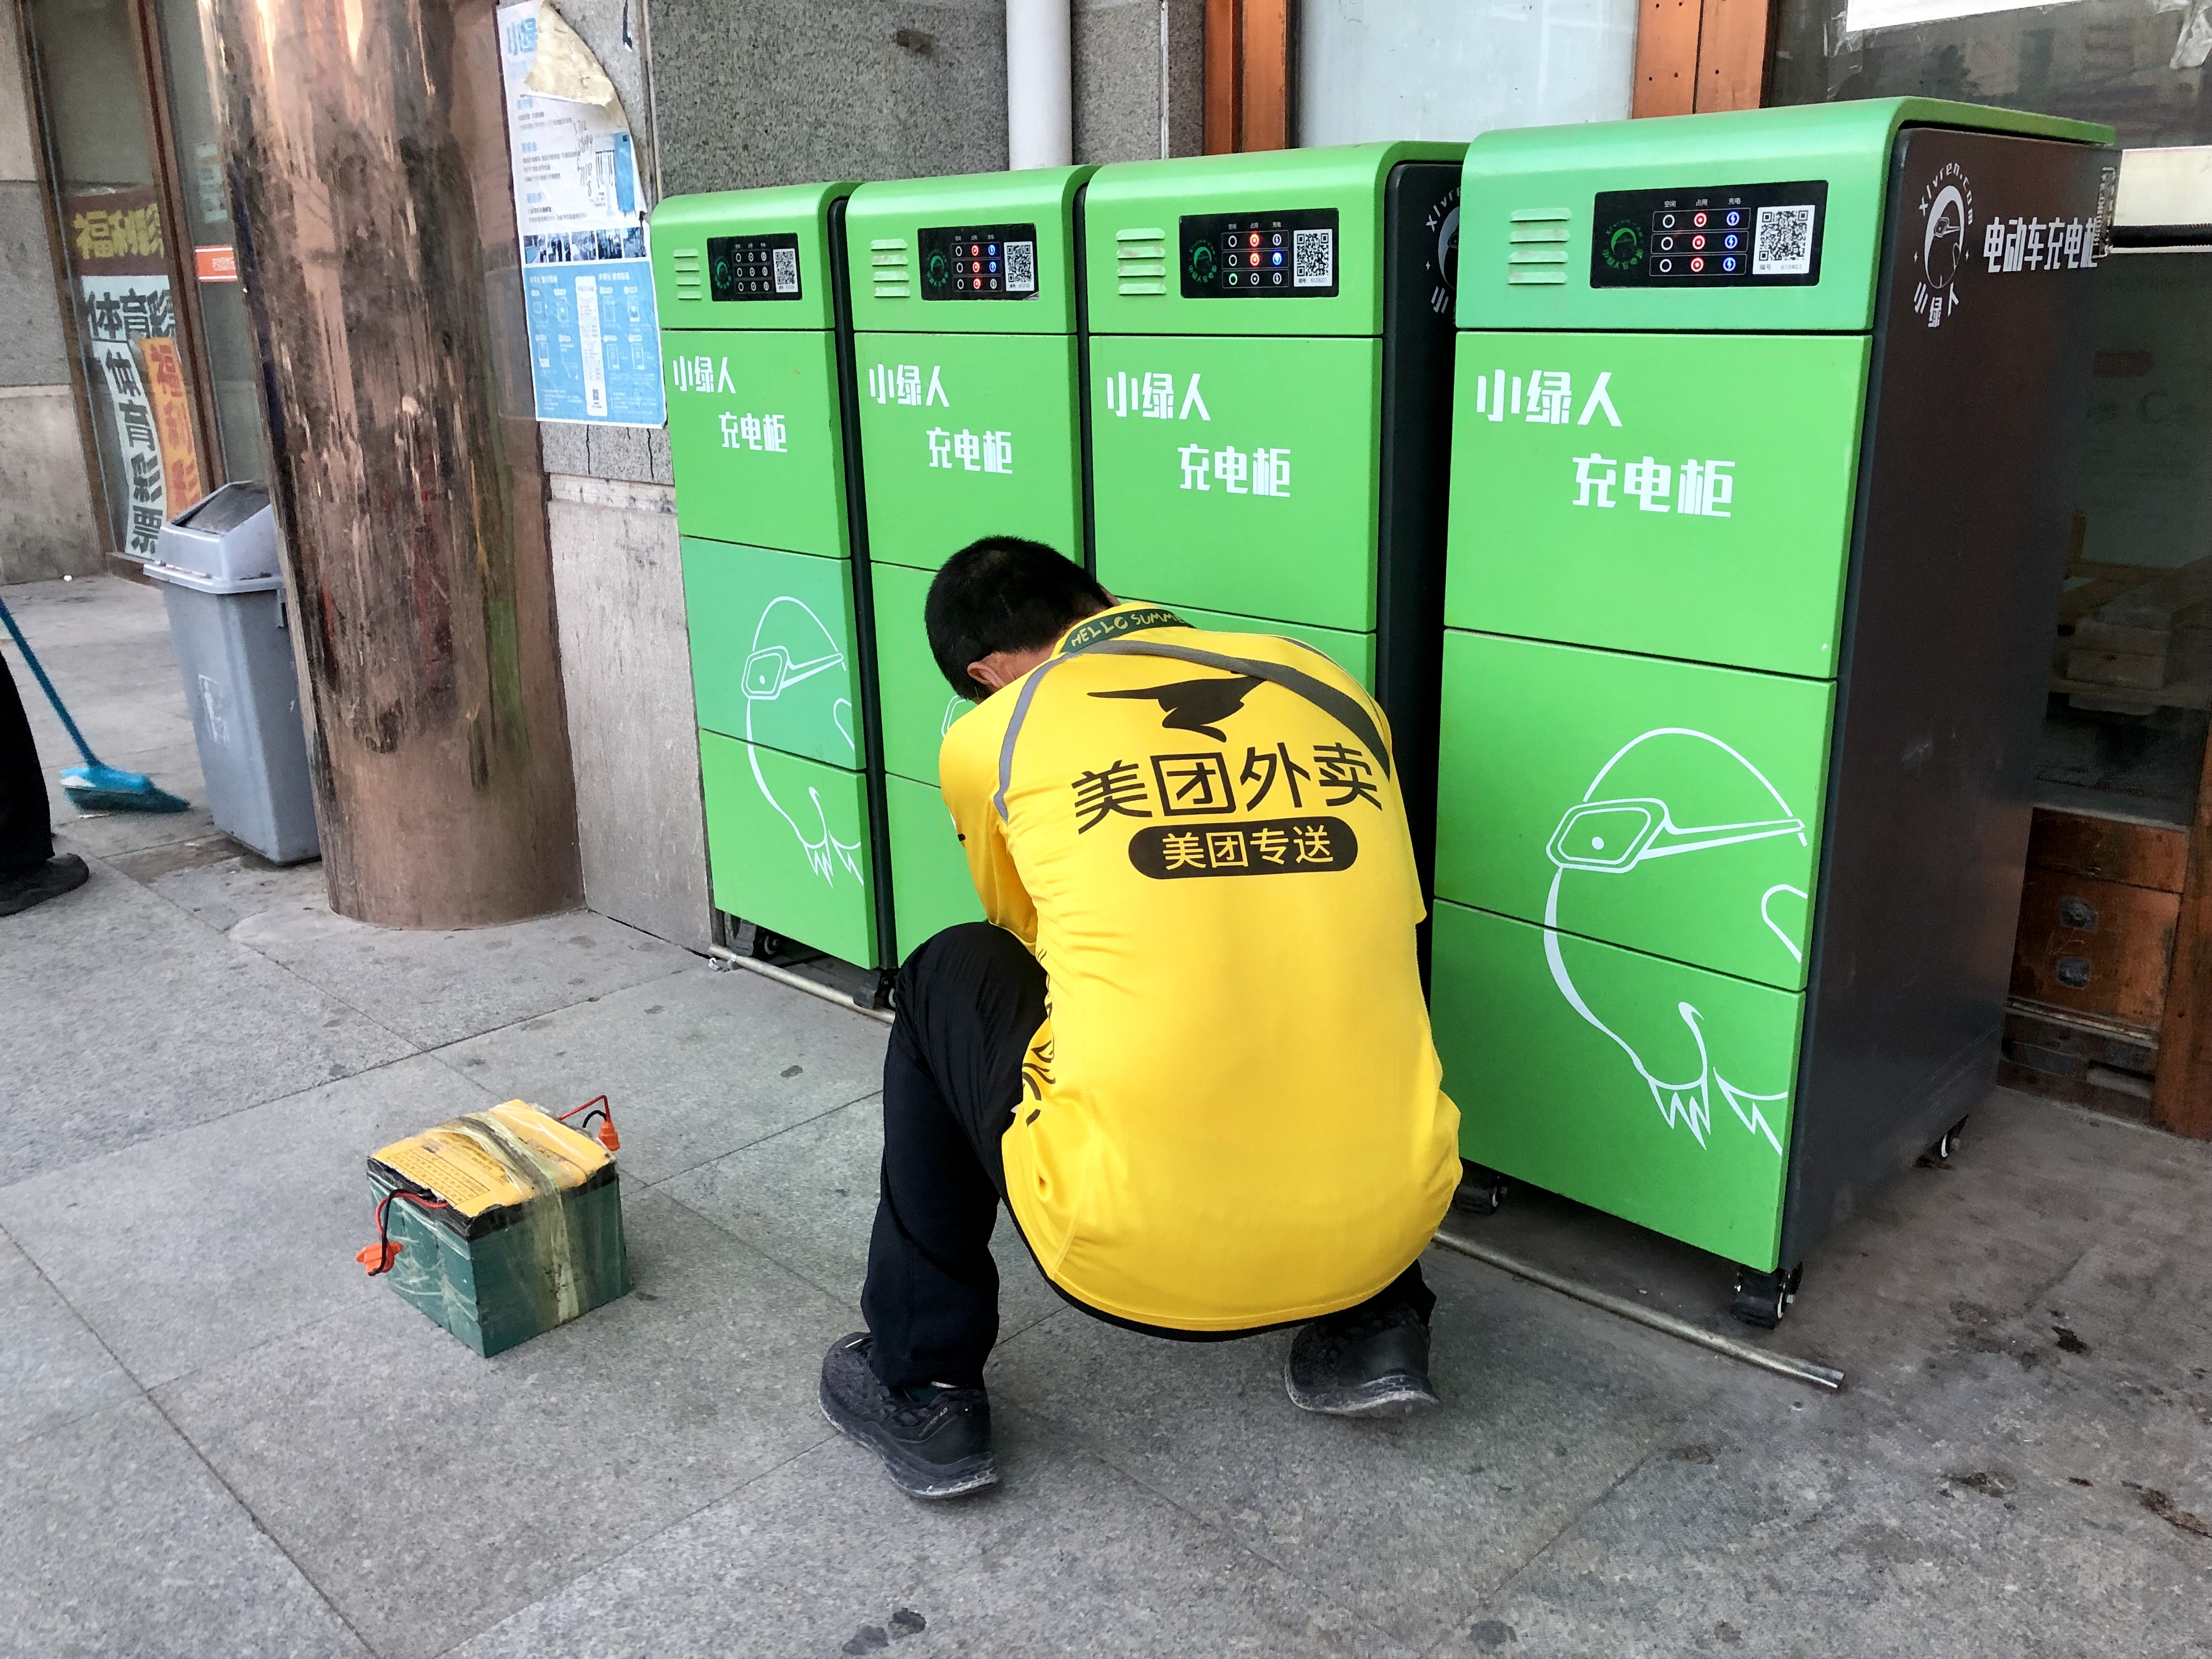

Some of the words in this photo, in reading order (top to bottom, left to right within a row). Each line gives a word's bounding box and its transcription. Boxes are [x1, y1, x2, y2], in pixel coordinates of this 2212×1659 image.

[1919, 162, 1973, 225] xlvren.com
[1914, 281, 1959, 328] 小绿人
[673, 356, 736, 394] 小绿人
[868, 364, 950, 407] 小绿人
[1107, 371, 1211, 421] 小绿人
[1476, 369, 1623, 427] 小绿人
[718, 411, 788, 453] 充电柜
[926, 426, 1013, 474] 充电柜
[1177, 443, 1291, 497] 充电柜
[1572, 453, 1735, 517] 充电柜
[1071, 616, 1128, 647] HELLO
[1071, 742, 1383, 834] 美团外卖
[1161, 824, 1334, 870] 美团专送
